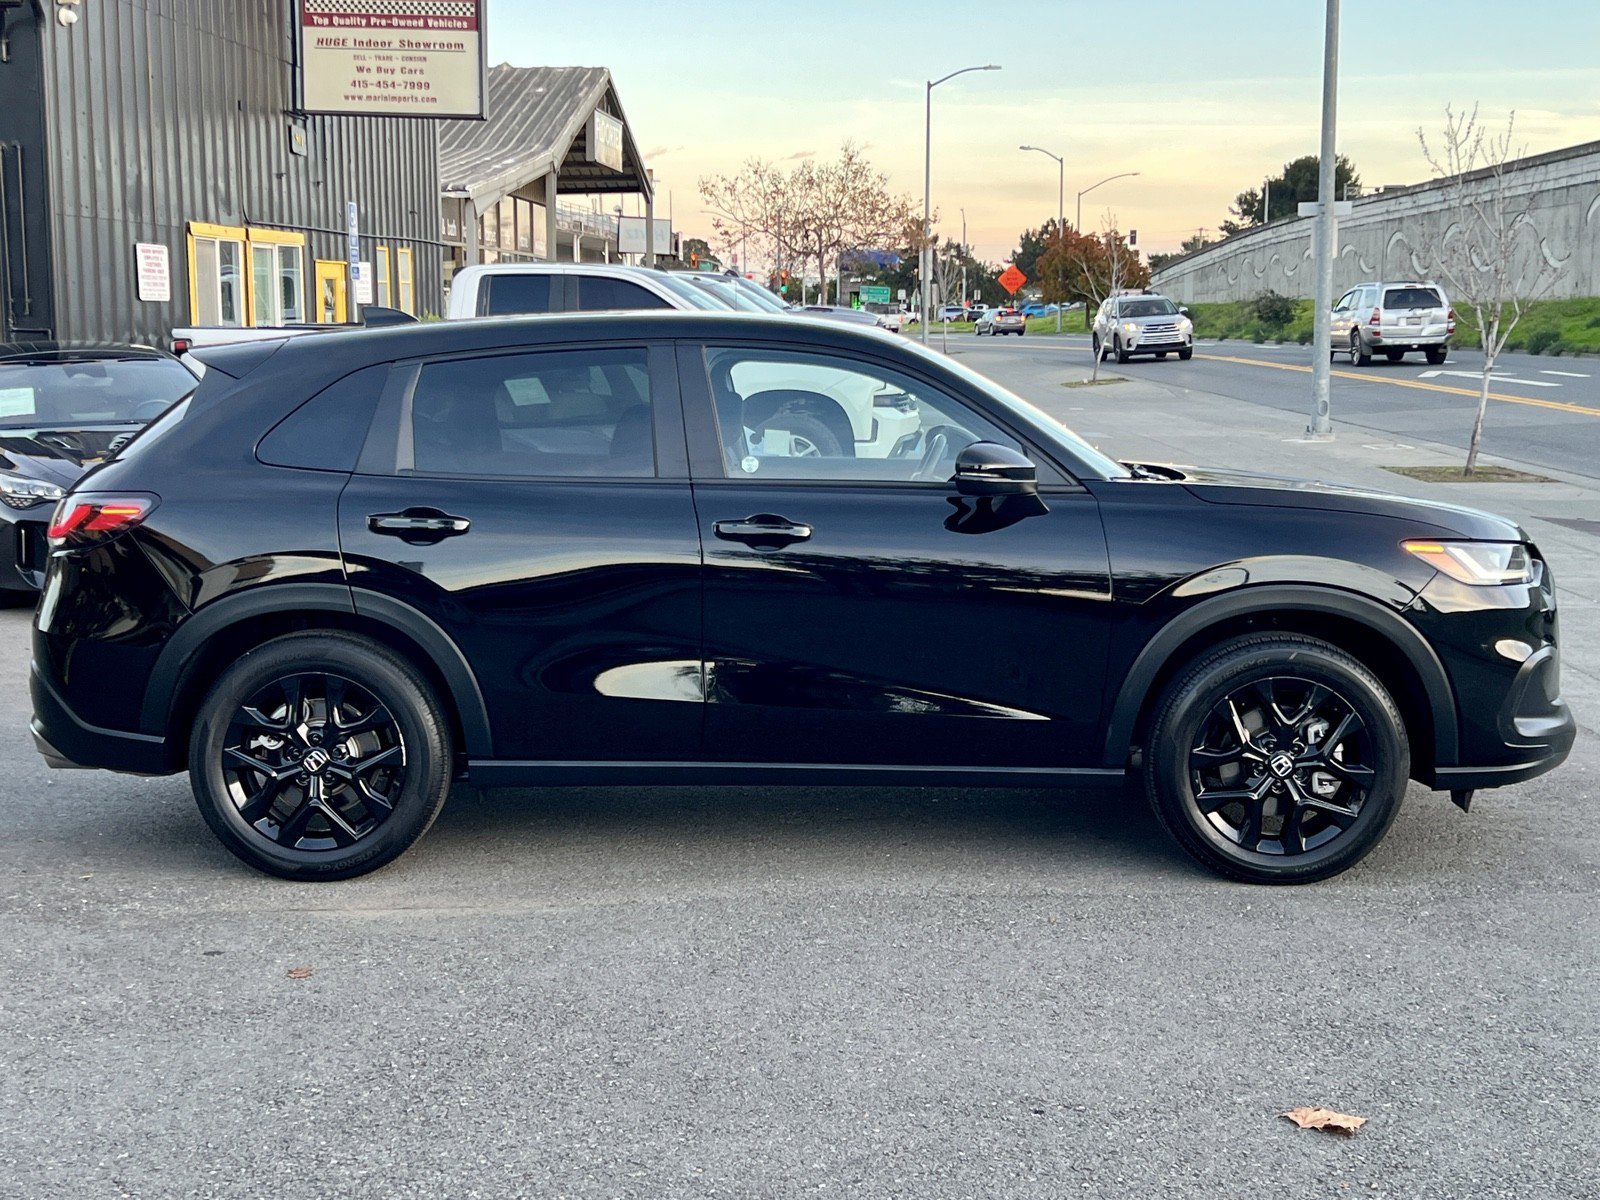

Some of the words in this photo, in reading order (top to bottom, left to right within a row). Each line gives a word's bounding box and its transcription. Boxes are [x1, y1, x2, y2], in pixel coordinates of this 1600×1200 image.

[312, 15, 329, 26] Top
[332, 15, 367, 27] Quality
[370, 16, 424, 28] Pre-Owned
[427, 17, 468, 29] Vehicles
[316, 37, 348, 47] HUGE
[353, 38, 393, 48] Indoor
[399, 39, 464, 50] Showroom
[374, 54, 393, 62] TRADE
[401, 55, 427, 63] CONSIGN
[356, 65, 372, 74] We
[376, 66, 395, 75] Buy
[400, 66, 425, 75] Cars
[351, 80, 430, 91] 415-454-7999
[343, 94, 437, 104] www.marinimports.com
